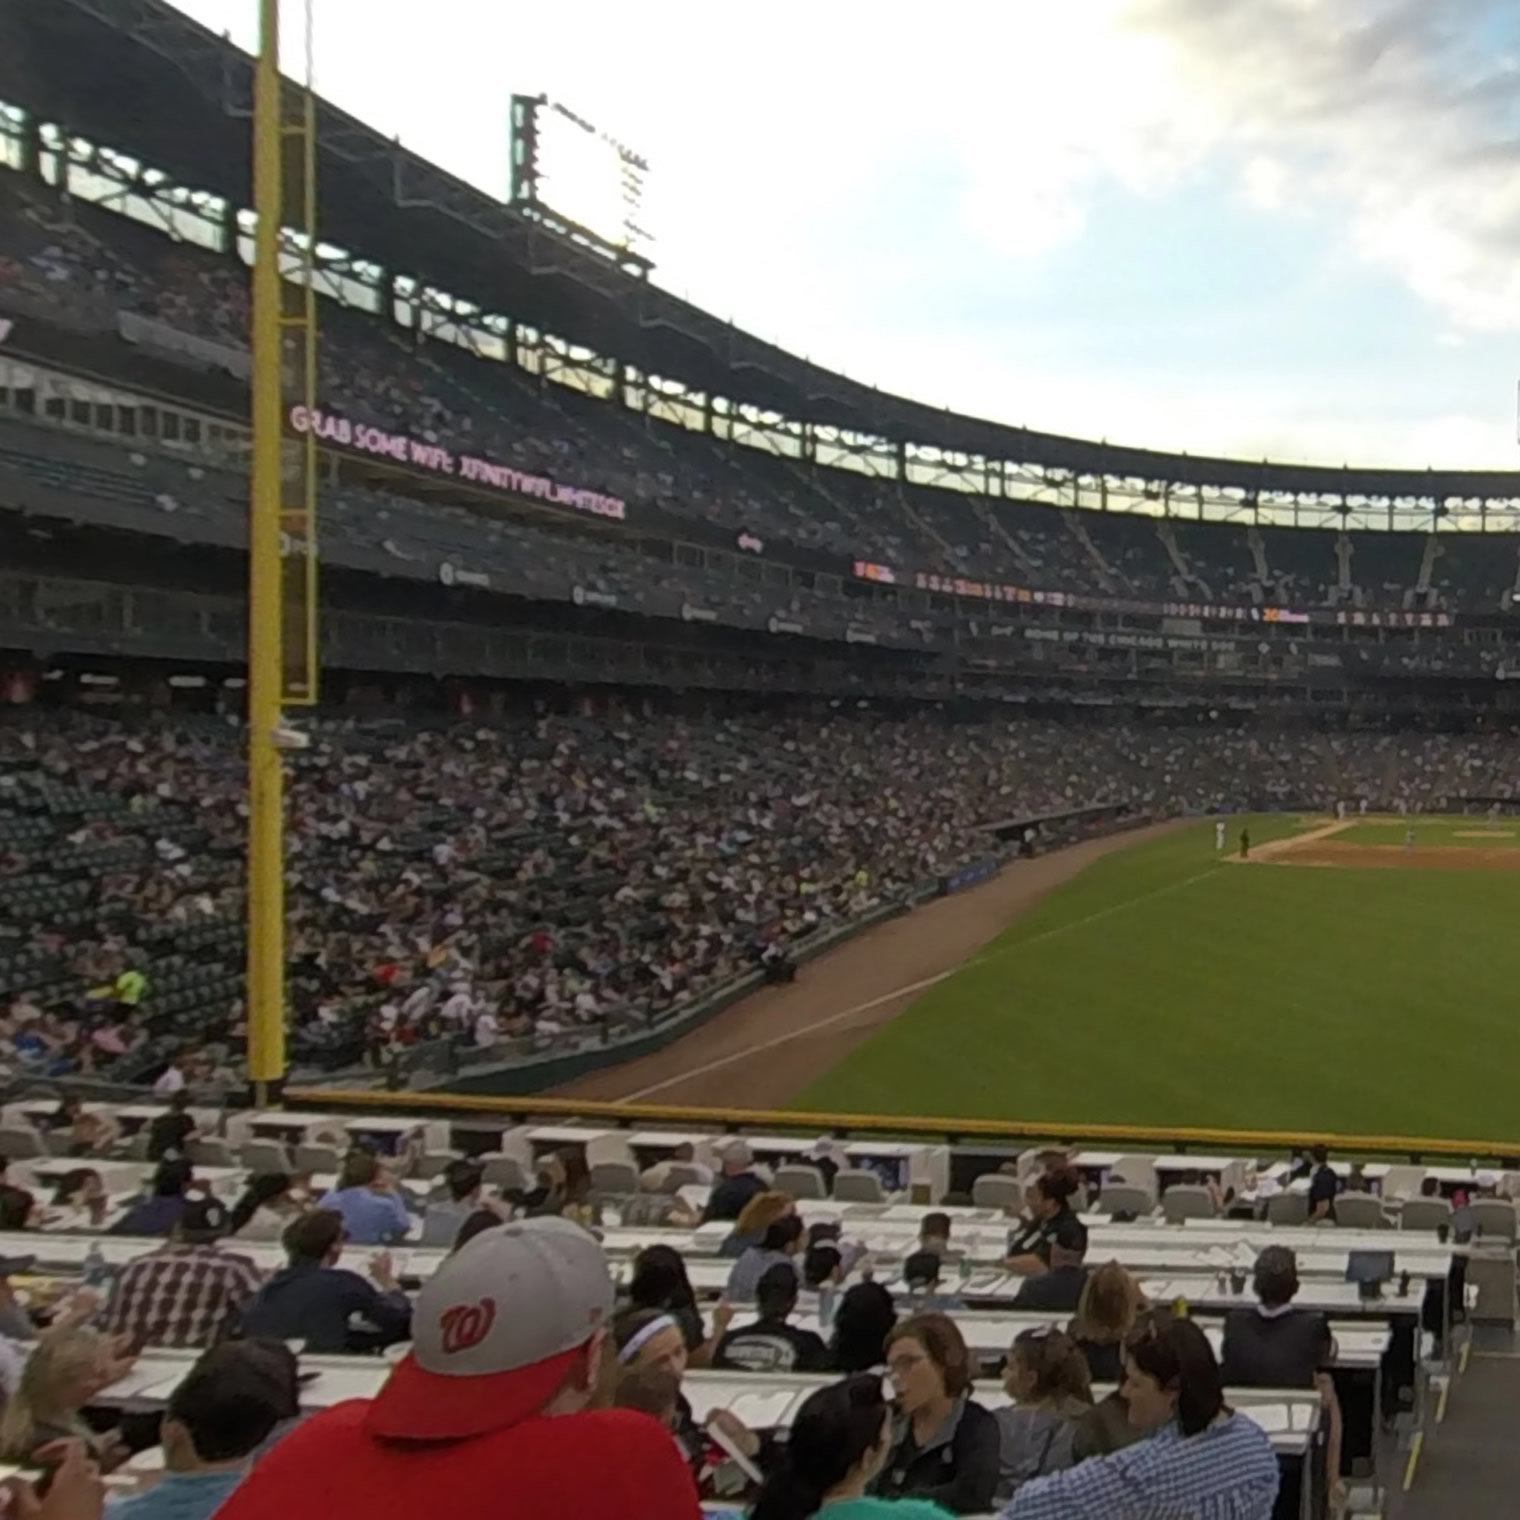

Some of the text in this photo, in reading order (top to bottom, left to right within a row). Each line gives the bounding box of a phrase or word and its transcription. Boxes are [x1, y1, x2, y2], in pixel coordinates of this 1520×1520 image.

[290, 405, 351, 444] GRAB
[354, 423, 408, 461] SOME
[440, 1297, 496, 1353] W
